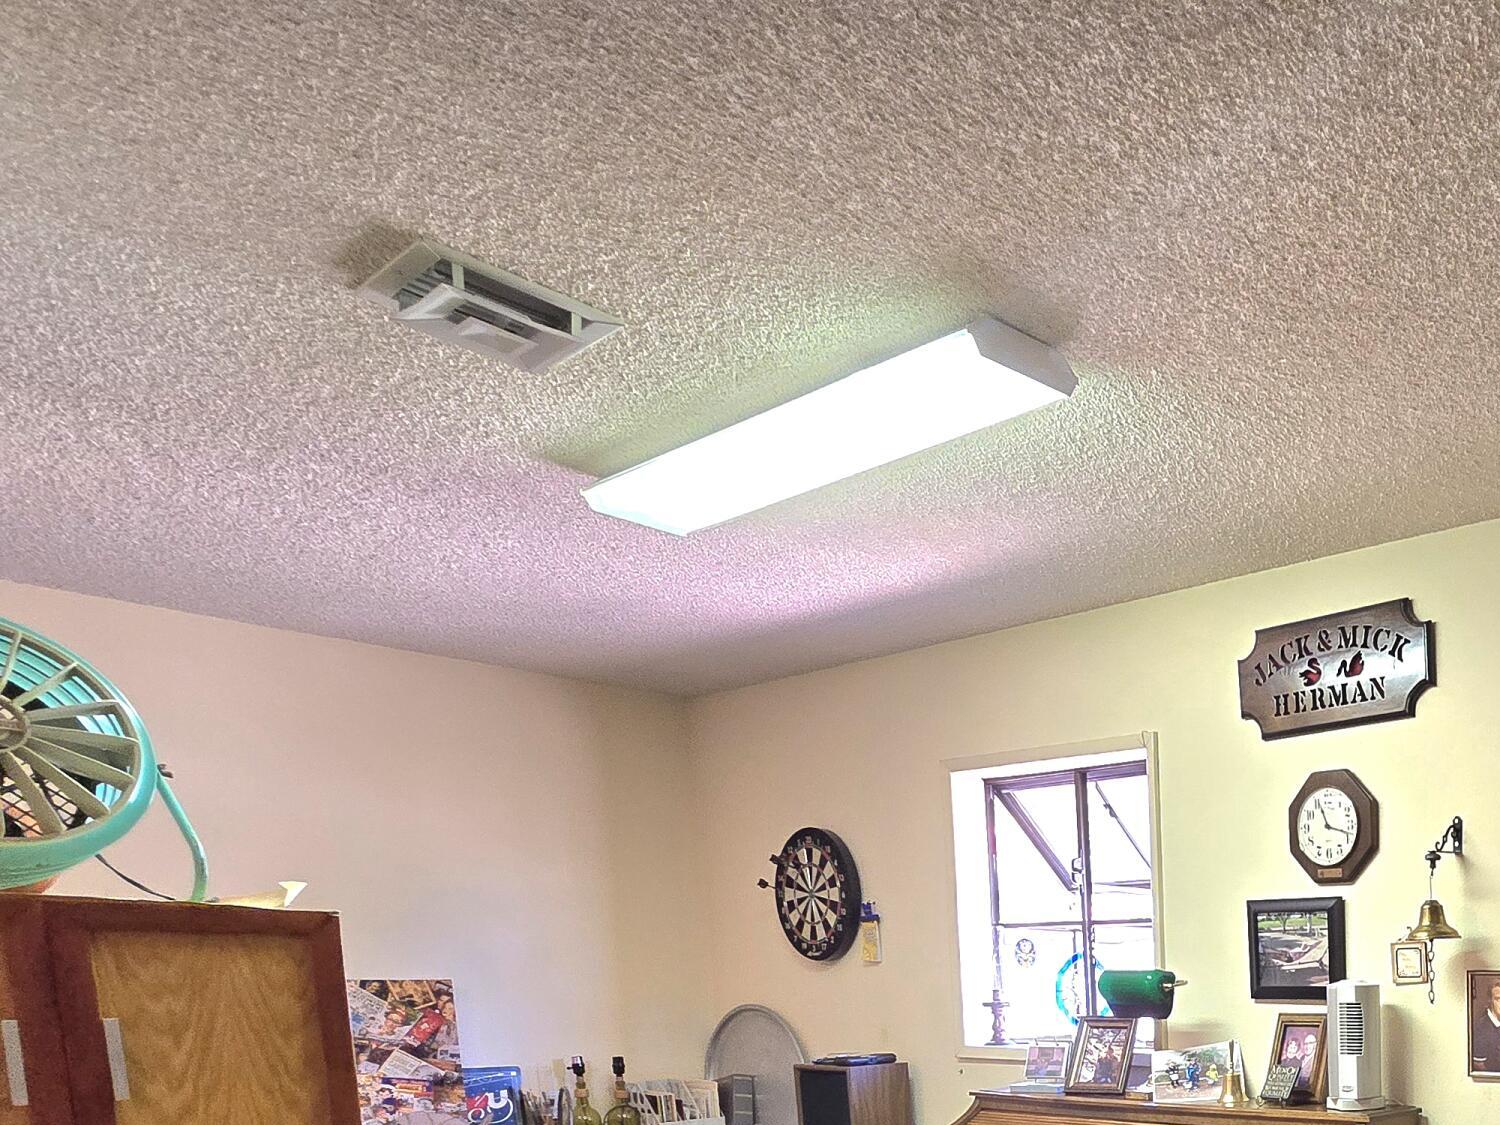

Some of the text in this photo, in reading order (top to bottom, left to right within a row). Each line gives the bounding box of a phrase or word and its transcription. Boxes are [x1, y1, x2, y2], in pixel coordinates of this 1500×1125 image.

[1254, 625, 1412, 687] JACK & MICK
[1273, 676, 1387, 718] HERMAN
